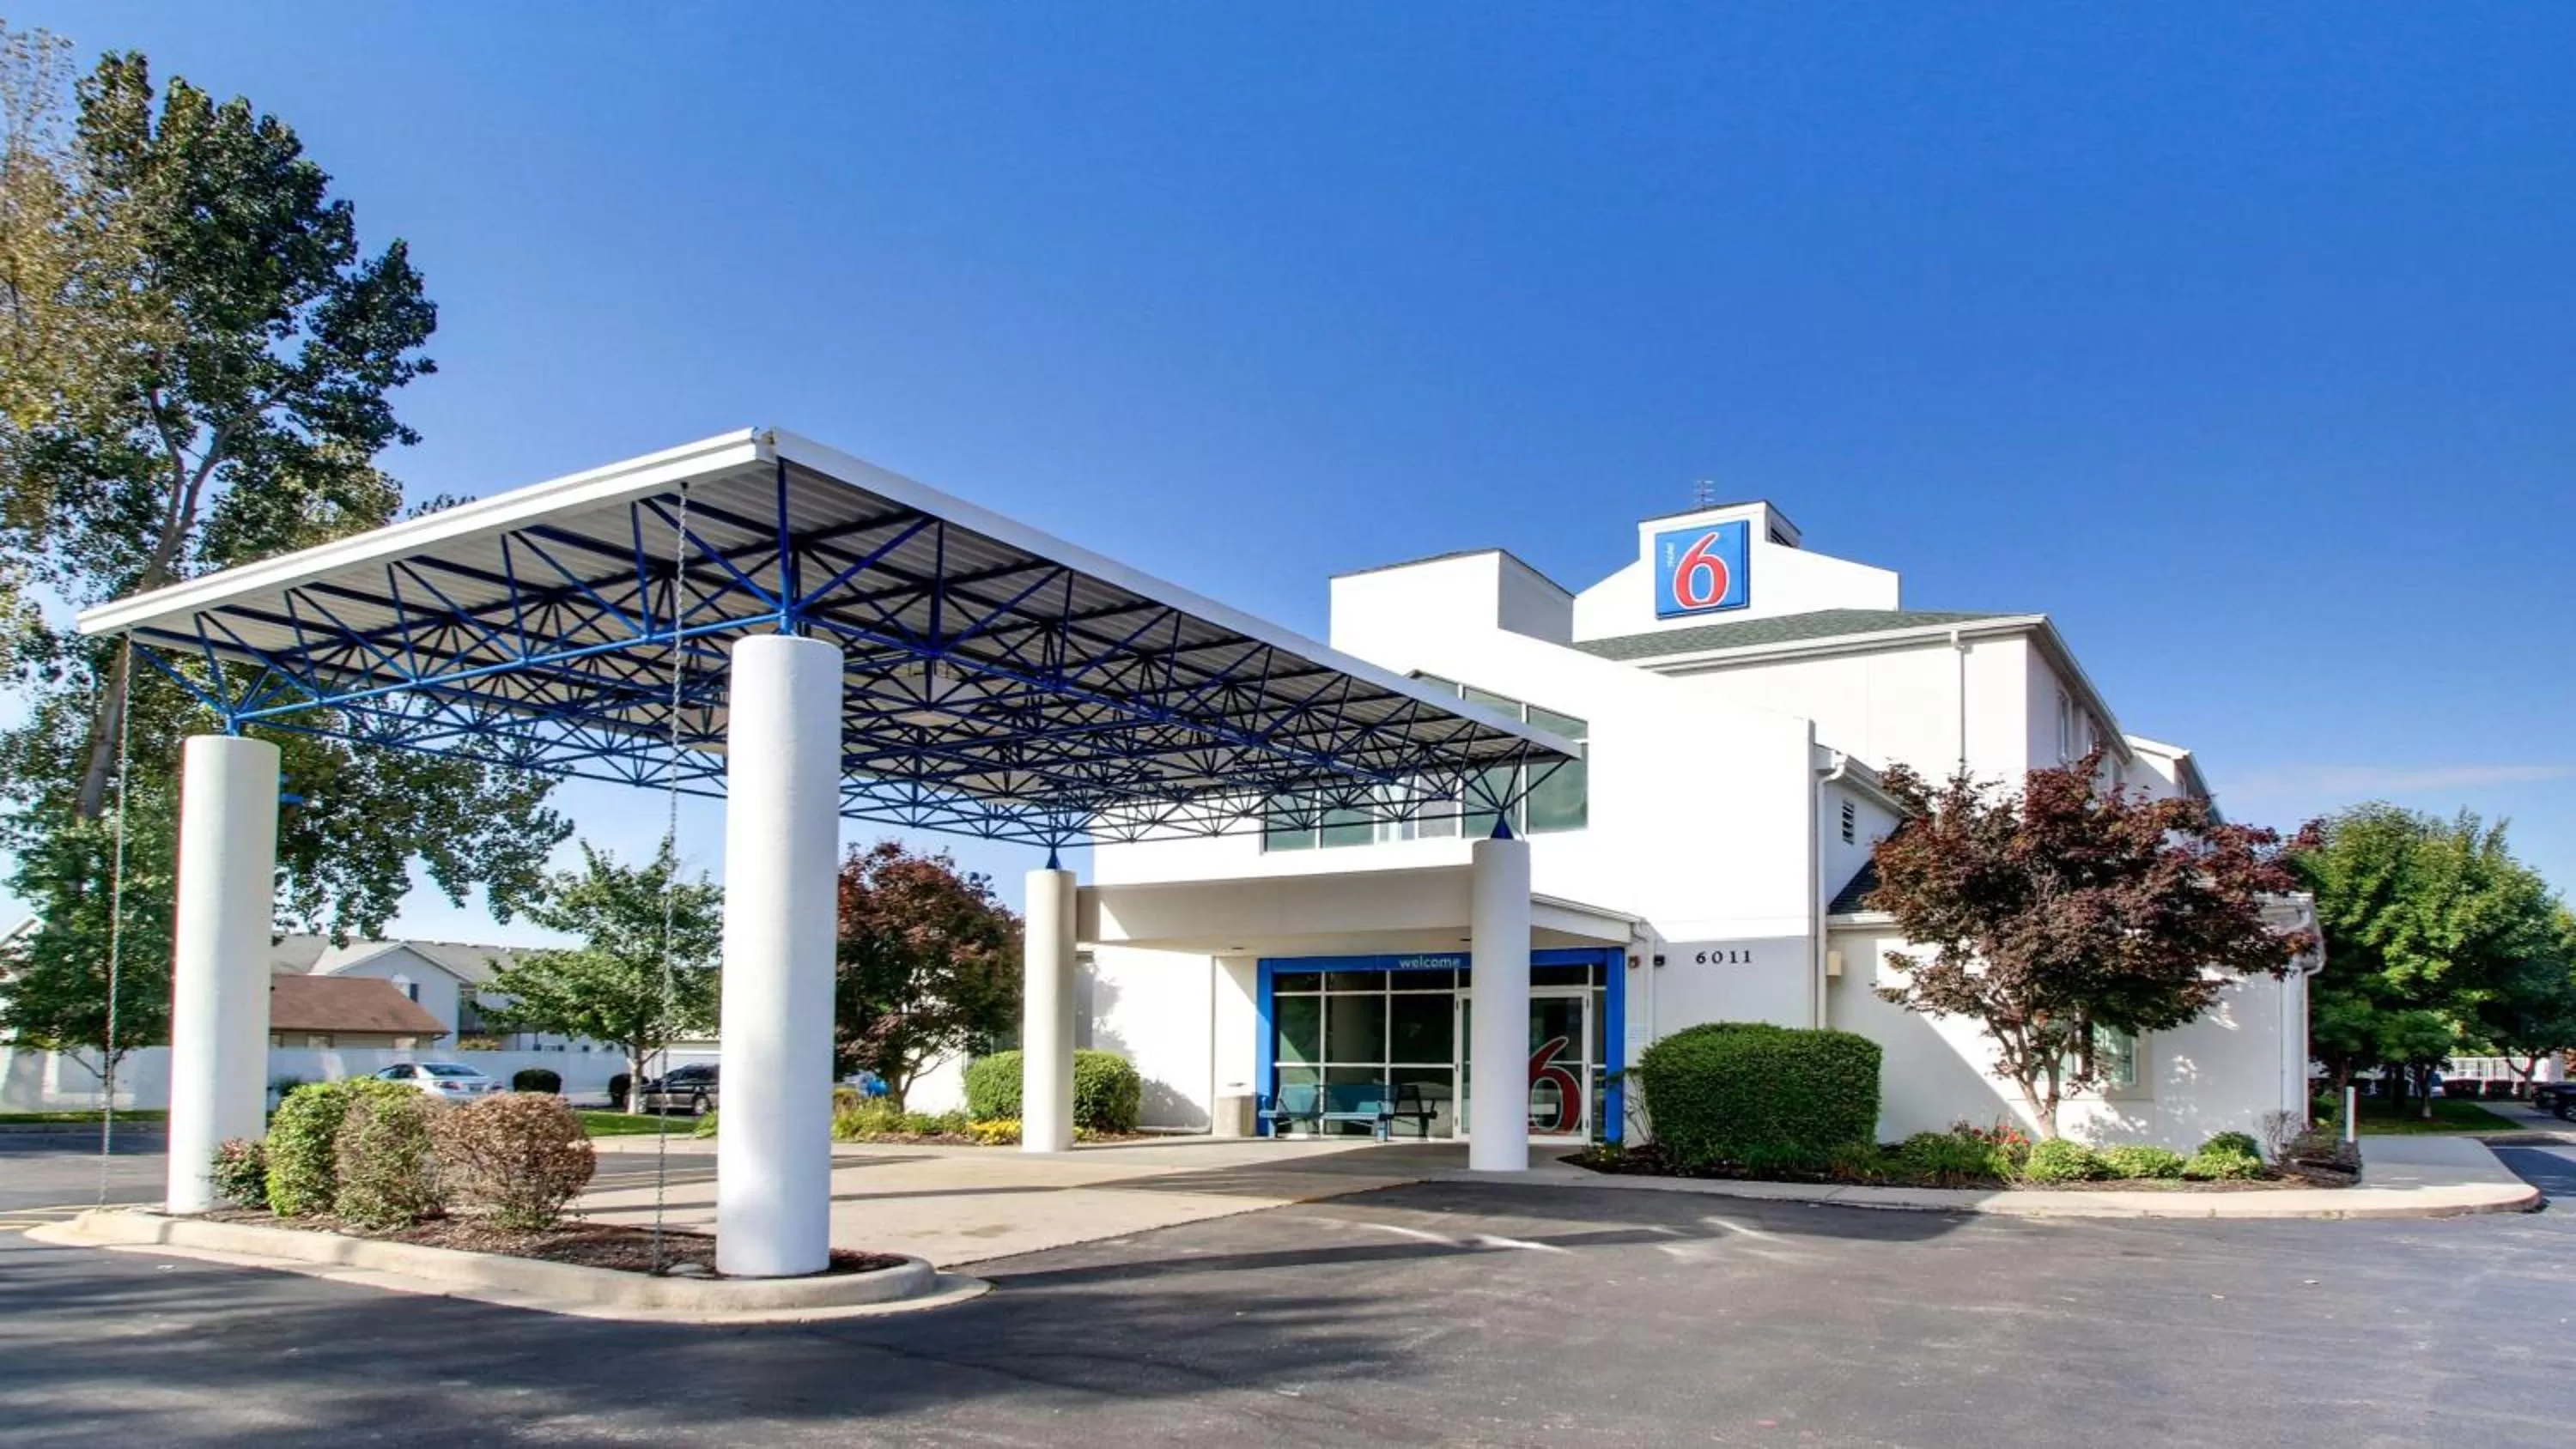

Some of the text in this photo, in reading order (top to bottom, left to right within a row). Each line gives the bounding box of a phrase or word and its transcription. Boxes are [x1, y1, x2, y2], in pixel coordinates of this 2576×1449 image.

[1674, 532, 1729, 609] 6
[1399, 955, 1461, 968] welcome
[1696, 950, 1752, 964] 6011
[1528, 1036, 1581, 1135] 6
